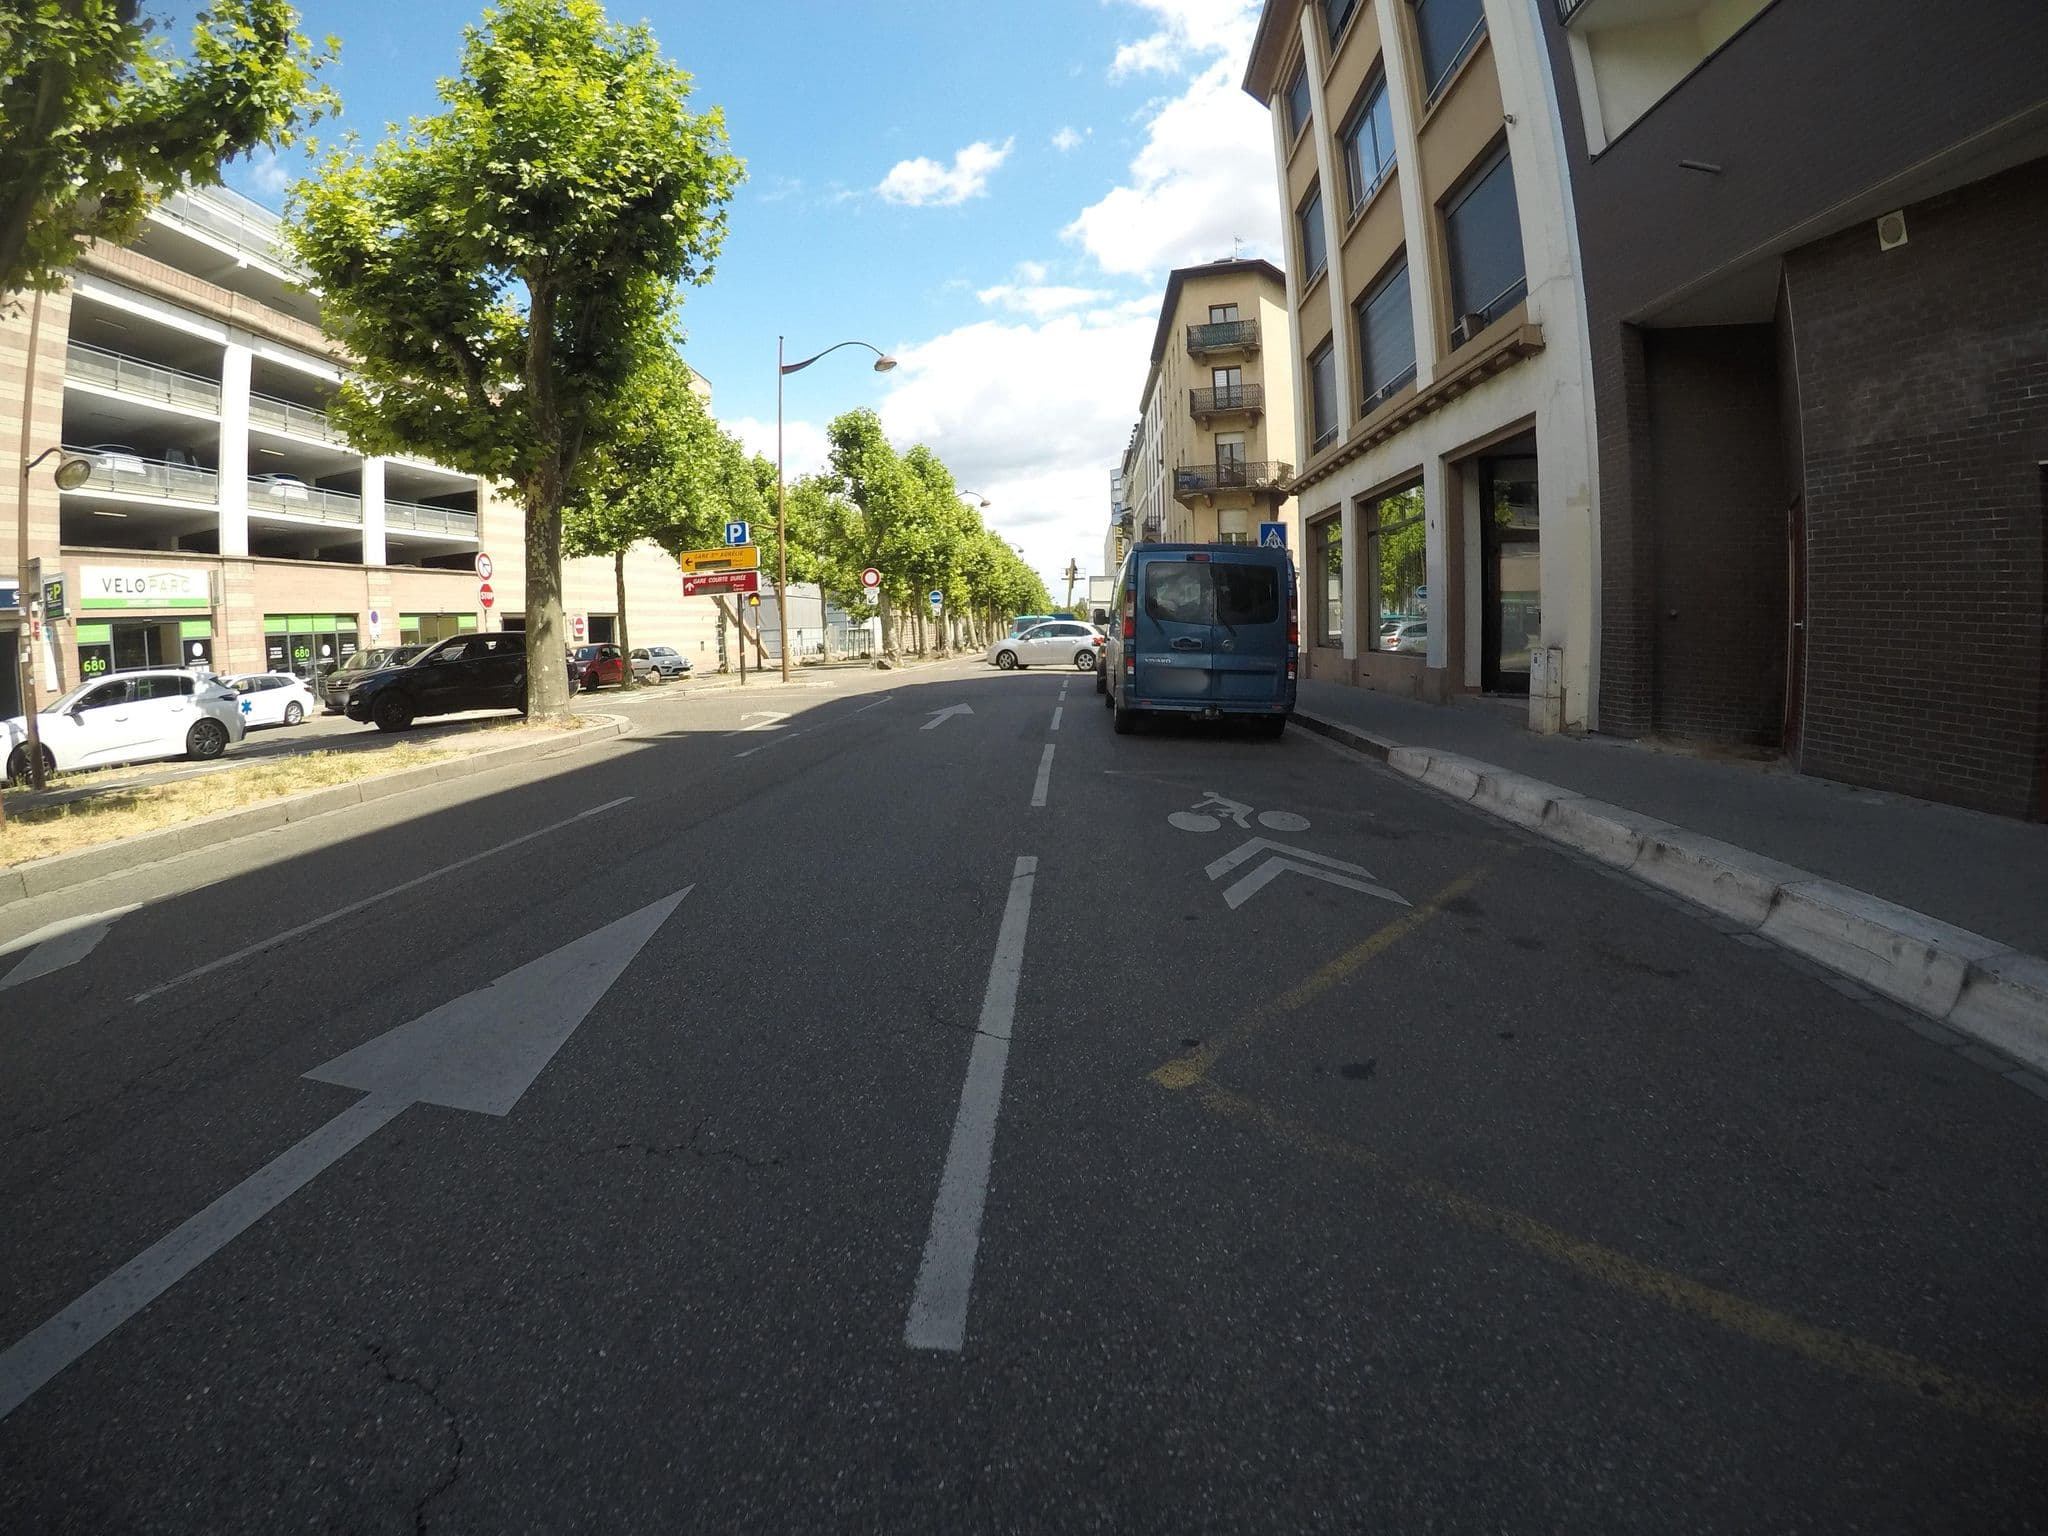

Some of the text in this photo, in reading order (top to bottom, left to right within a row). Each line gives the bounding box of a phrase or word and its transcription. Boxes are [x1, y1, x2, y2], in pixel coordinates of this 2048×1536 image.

[730, 525, 742, 542] P
[481, 591, 494, 600] STOP
[294, 648, 310, 658] 680
[83, 659, 106, 672] 680
